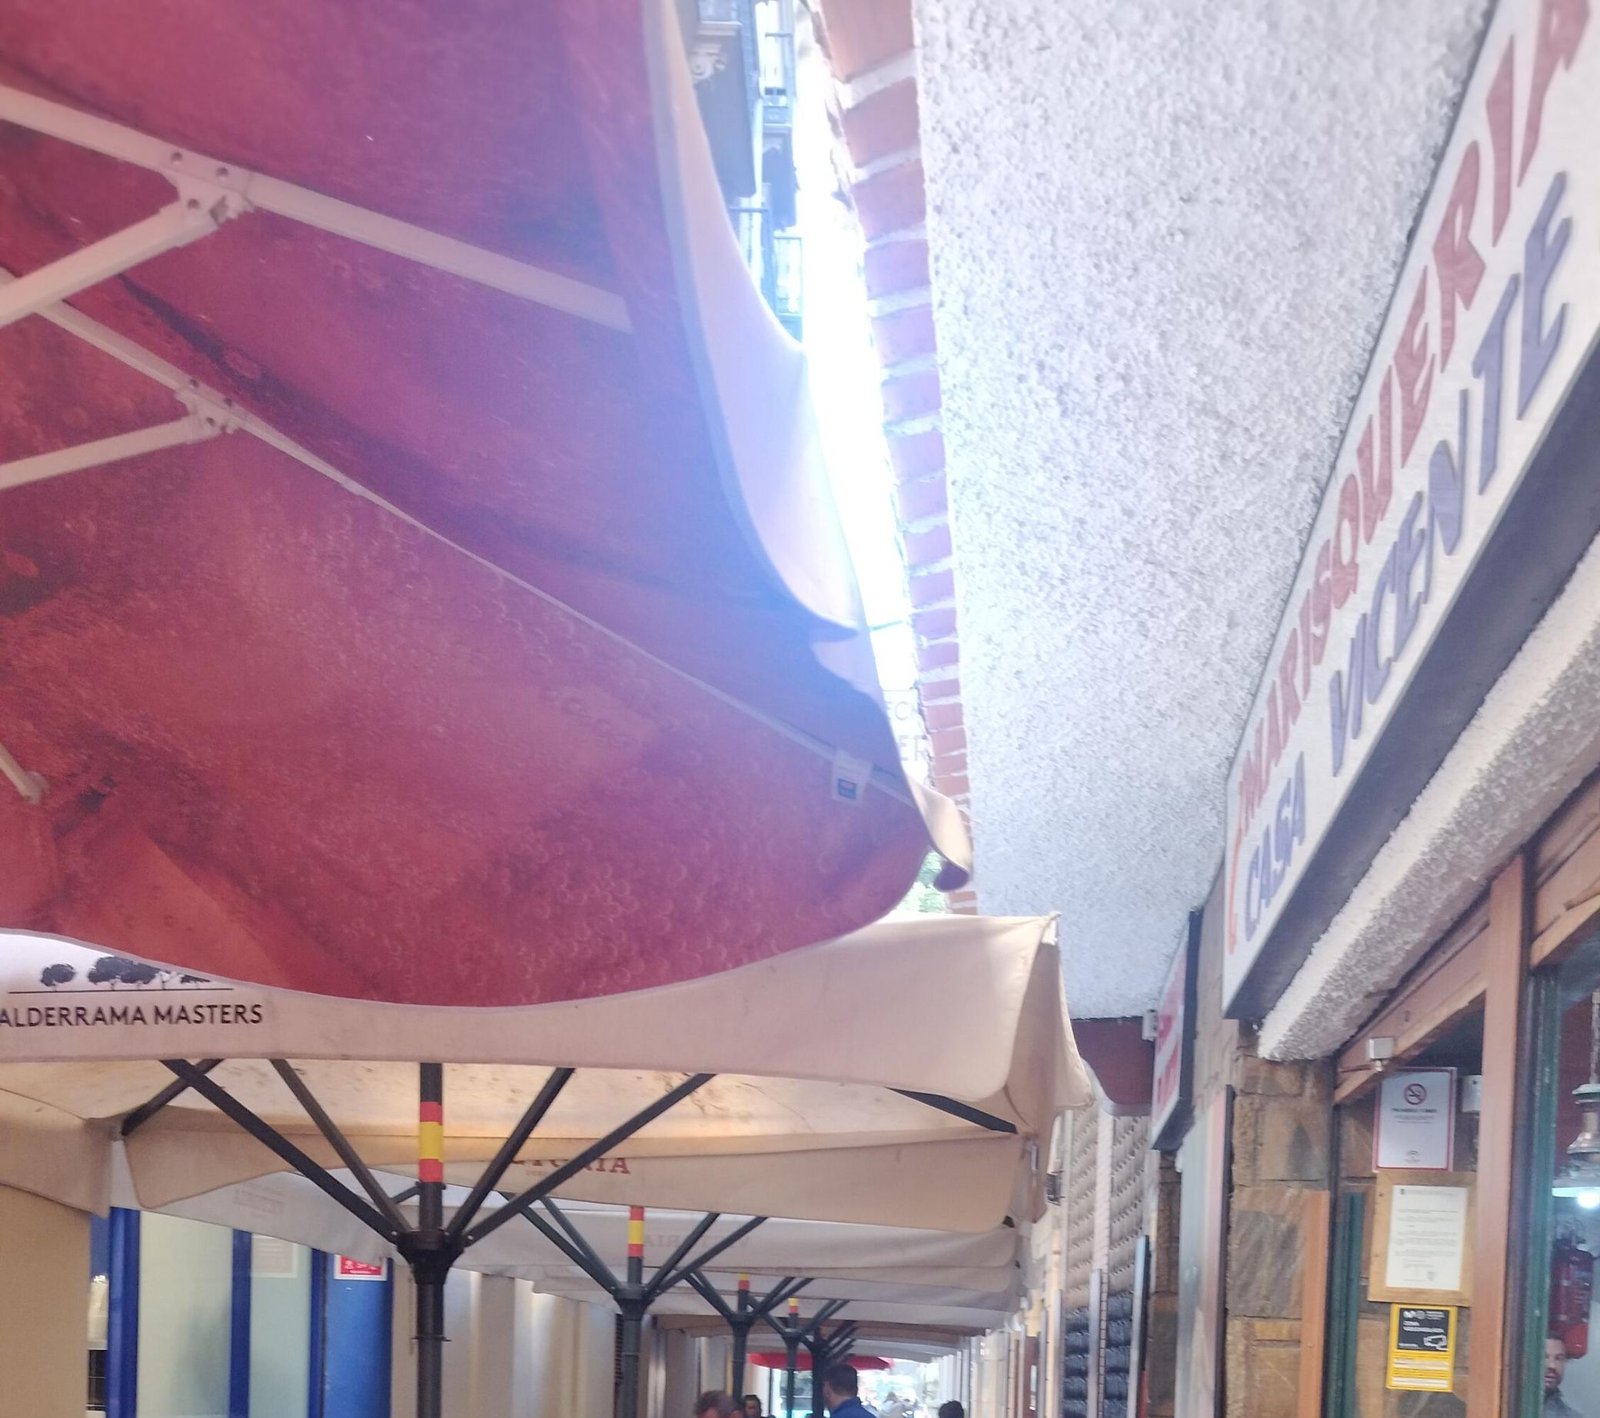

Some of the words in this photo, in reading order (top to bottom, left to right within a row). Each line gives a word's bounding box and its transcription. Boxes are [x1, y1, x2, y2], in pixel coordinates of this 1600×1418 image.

[1245, 751, 1306, 942] CASA
[1329, 170, 1572, 778] VICENTE
[154, 1004, 263, 1025] MASTERS
